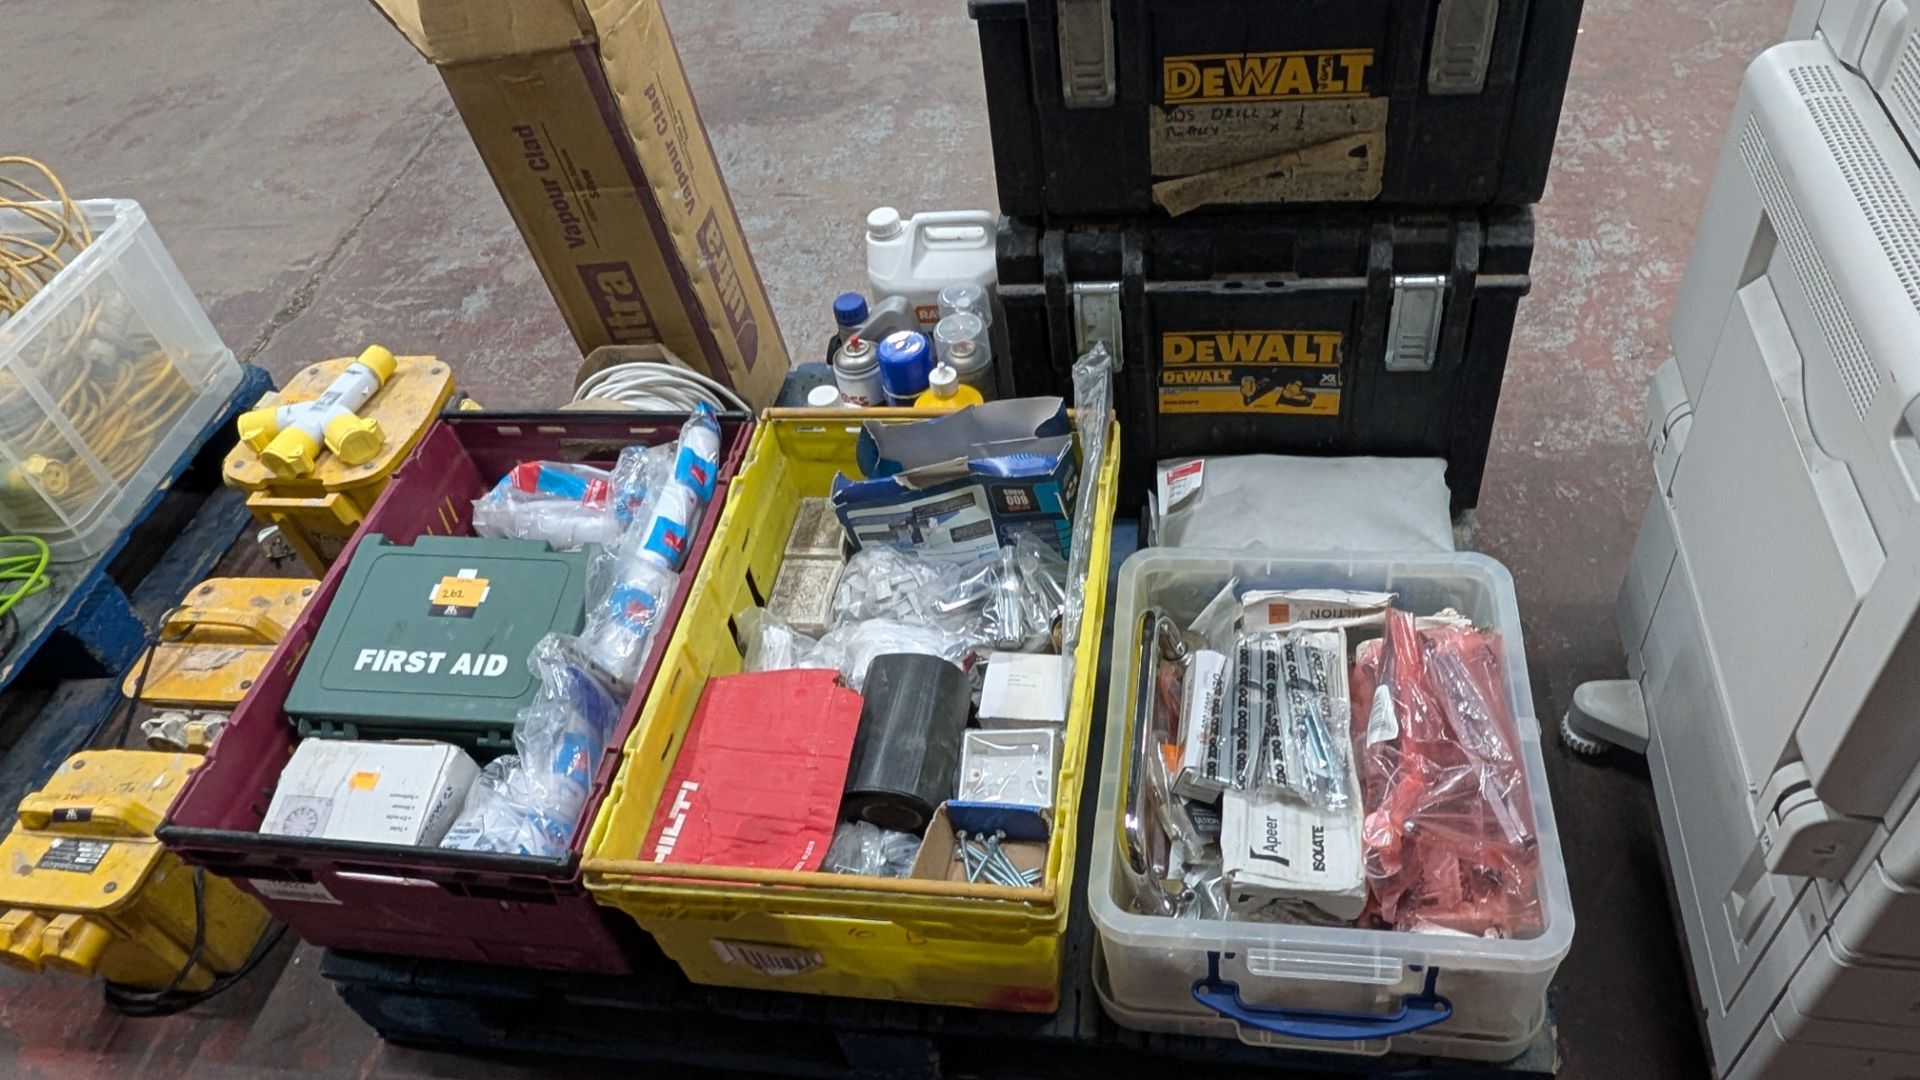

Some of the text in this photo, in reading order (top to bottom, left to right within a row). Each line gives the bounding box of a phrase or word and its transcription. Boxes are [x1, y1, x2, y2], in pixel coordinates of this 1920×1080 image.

[1164, 55, 1374, 97] DEWALT
[643, 82, 669, 137] Clad
[1210, 108, 1260, 121] DRILL
[511, 123, 550, 172] Clad
[664, 139, 696, 216] Vapour
[541, 177, 586, 250] Vapour
[596, 269, 656, 344] ltra
[1163, 334, 1342, 363] DEWALT
[1163, 369, 1232, 385] DEWALT
[353, 648, 509, 677] FIRST AID
[1263, 815, 1282, 854] Apeer
[1312, 825, 1326, 872] ISOLATE
